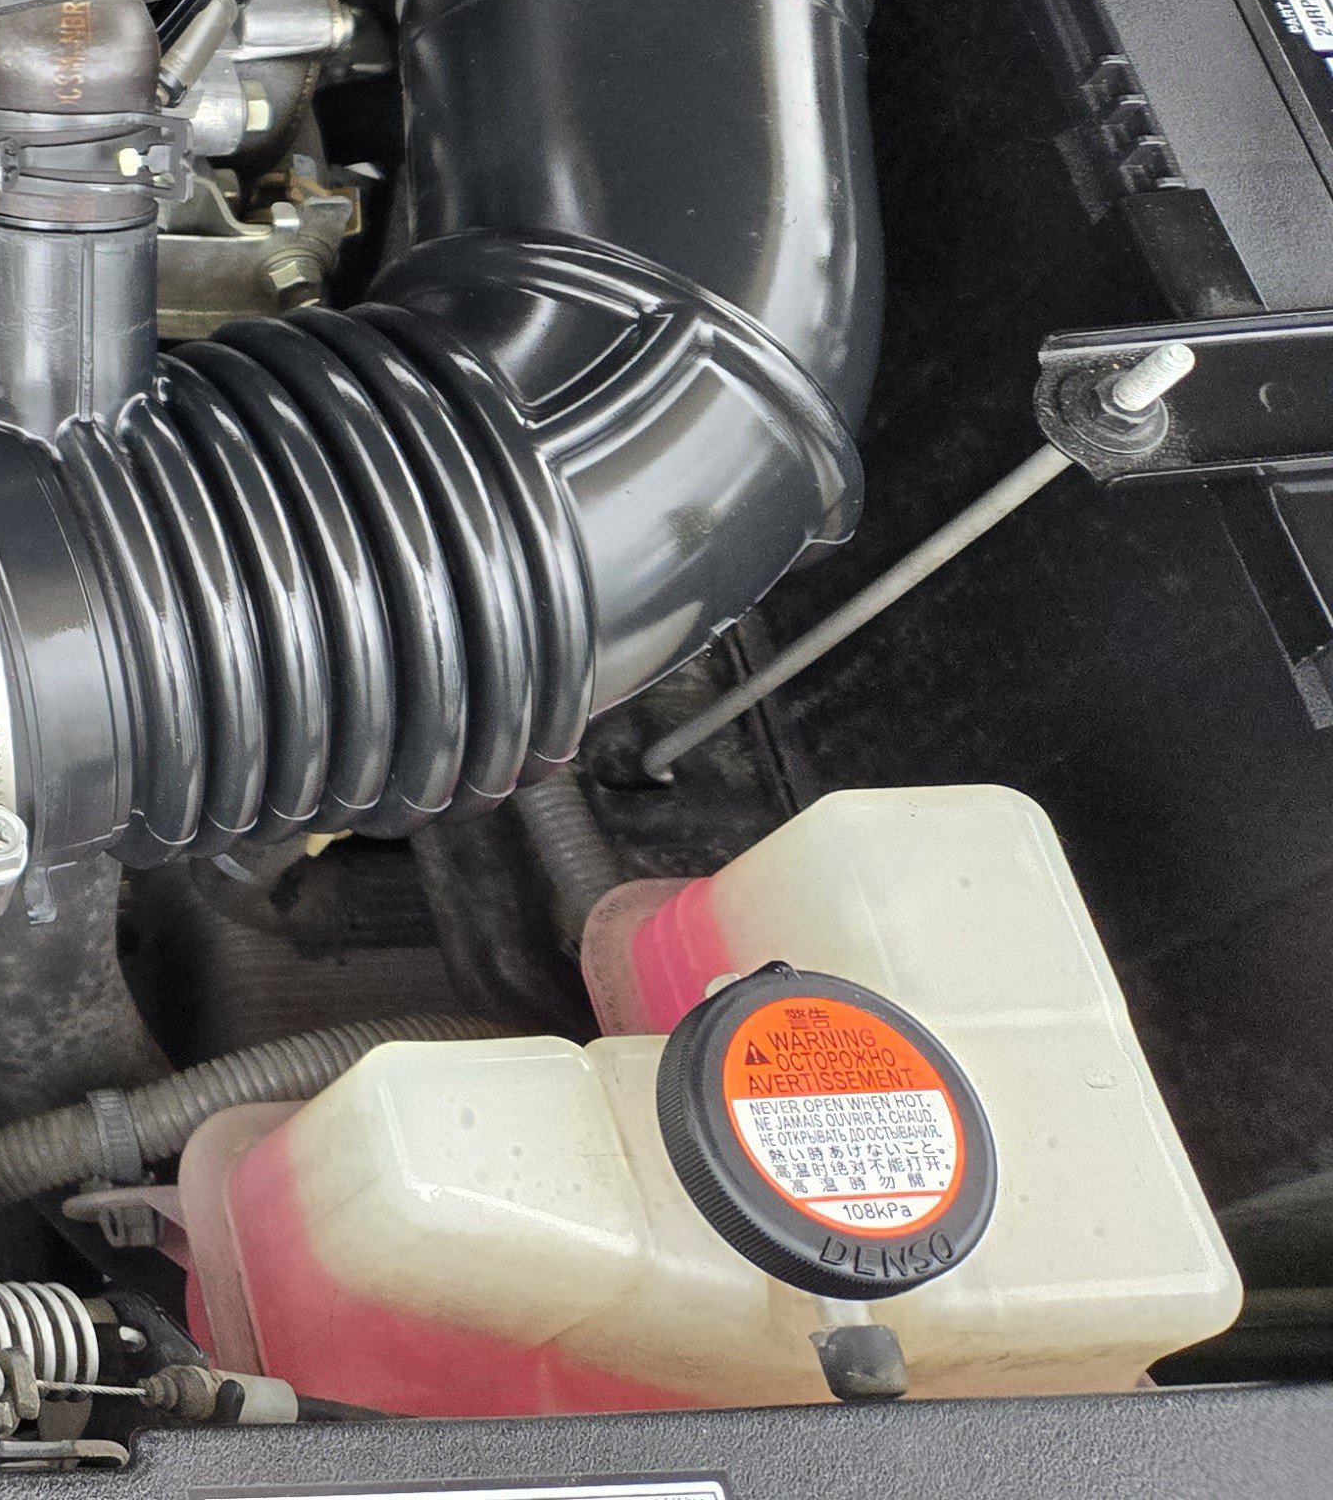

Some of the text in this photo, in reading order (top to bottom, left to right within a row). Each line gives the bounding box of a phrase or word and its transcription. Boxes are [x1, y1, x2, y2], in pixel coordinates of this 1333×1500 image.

[1275, 1, 1304, 34] PART
[785, 1007, 830, 1030] 警告
[766, 1029, 876, 1051] WARNING
[776, 1048, 896, 1072] ОСТОРОЖНО
[749, 1068, 914, 1096] AVERTISSEMENT
[749, 1094, 931, 1115] NEVER OPEN WHEN HOT.
[754, 1116, 773, 1131] NE
[776, 1114, 823, 1130] JAMAIS
[826, 1112, 874, 1128] OUVRIR
[889, 1109, 937, 1125] CHAUD.
[759, 1124, 942, 1148] НЕ ОТКРЫВАТЬ ДО ОСТЫВАНИЯ.
[768, 1139, 946, 1164] 熱い時あけないこと。
[773, 1155, 951, 1179] 高温时绝对不能打开。
[842, 1202, 913, 1221] 108kPa
[819, 1229, 956, 1278] DENSO
